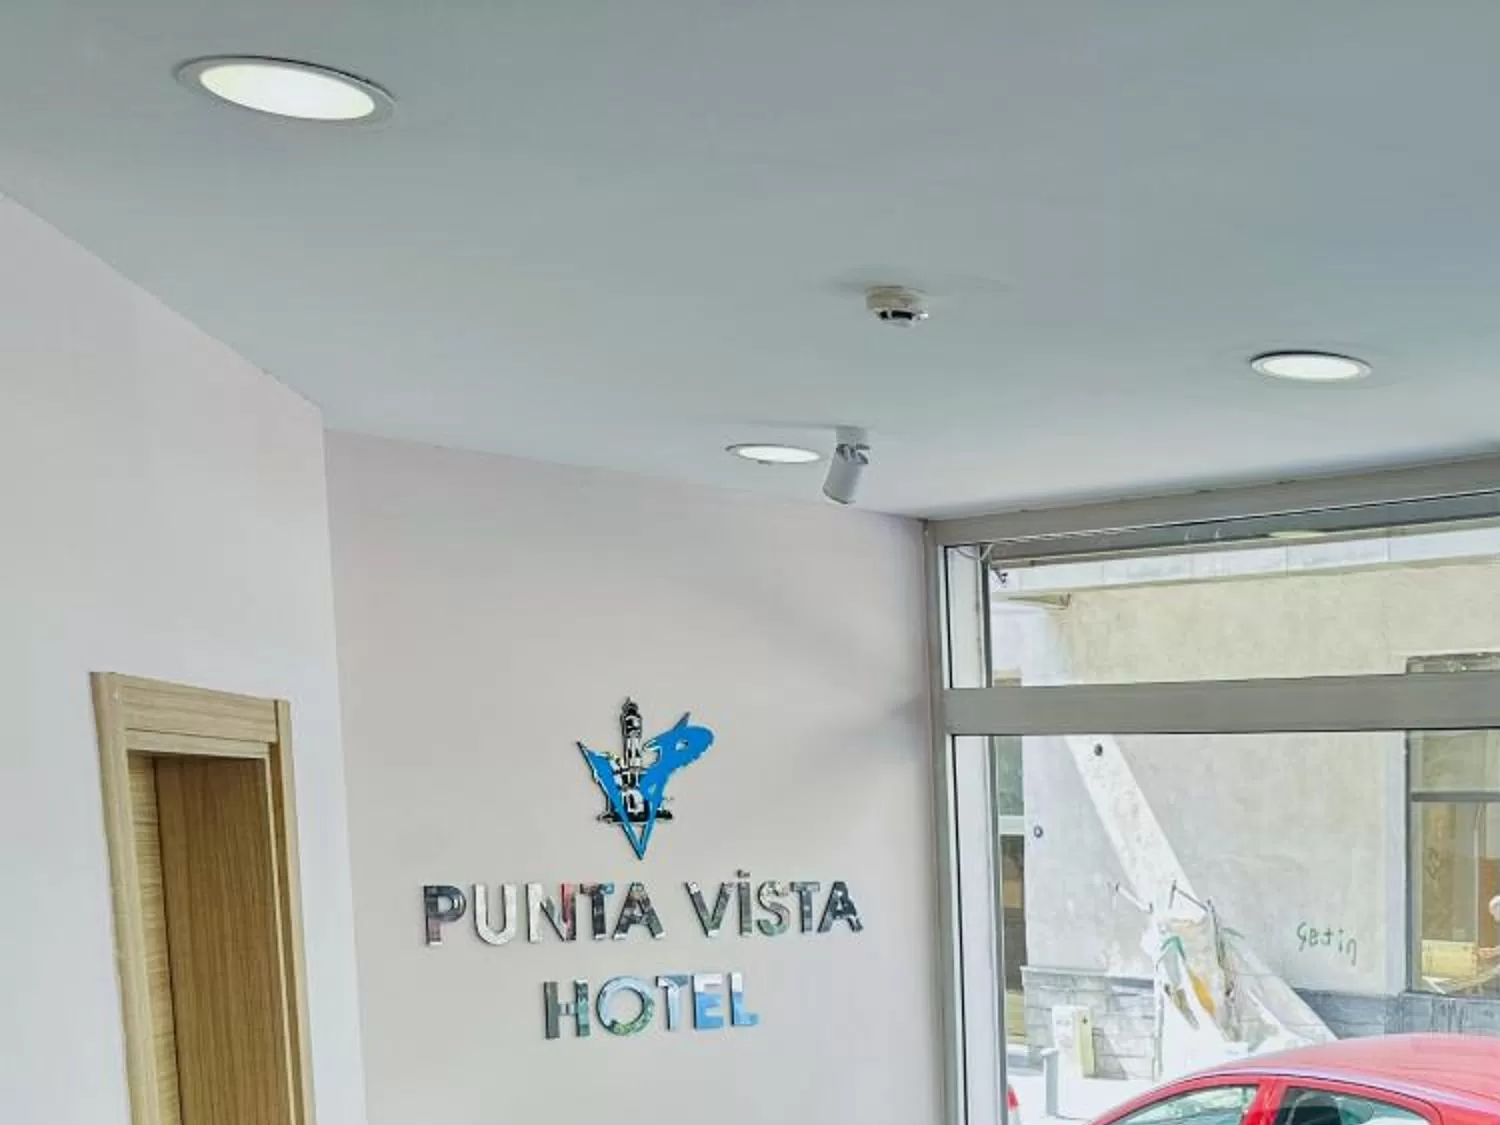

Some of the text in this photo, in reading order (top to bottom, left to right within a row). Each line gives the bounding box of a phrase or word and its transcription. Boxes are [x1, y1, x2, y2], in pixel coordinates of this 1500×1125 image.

[422, 870, 864, 946] PUNTA VİSTA
[543, 972, 760, 1040] HOTEL
